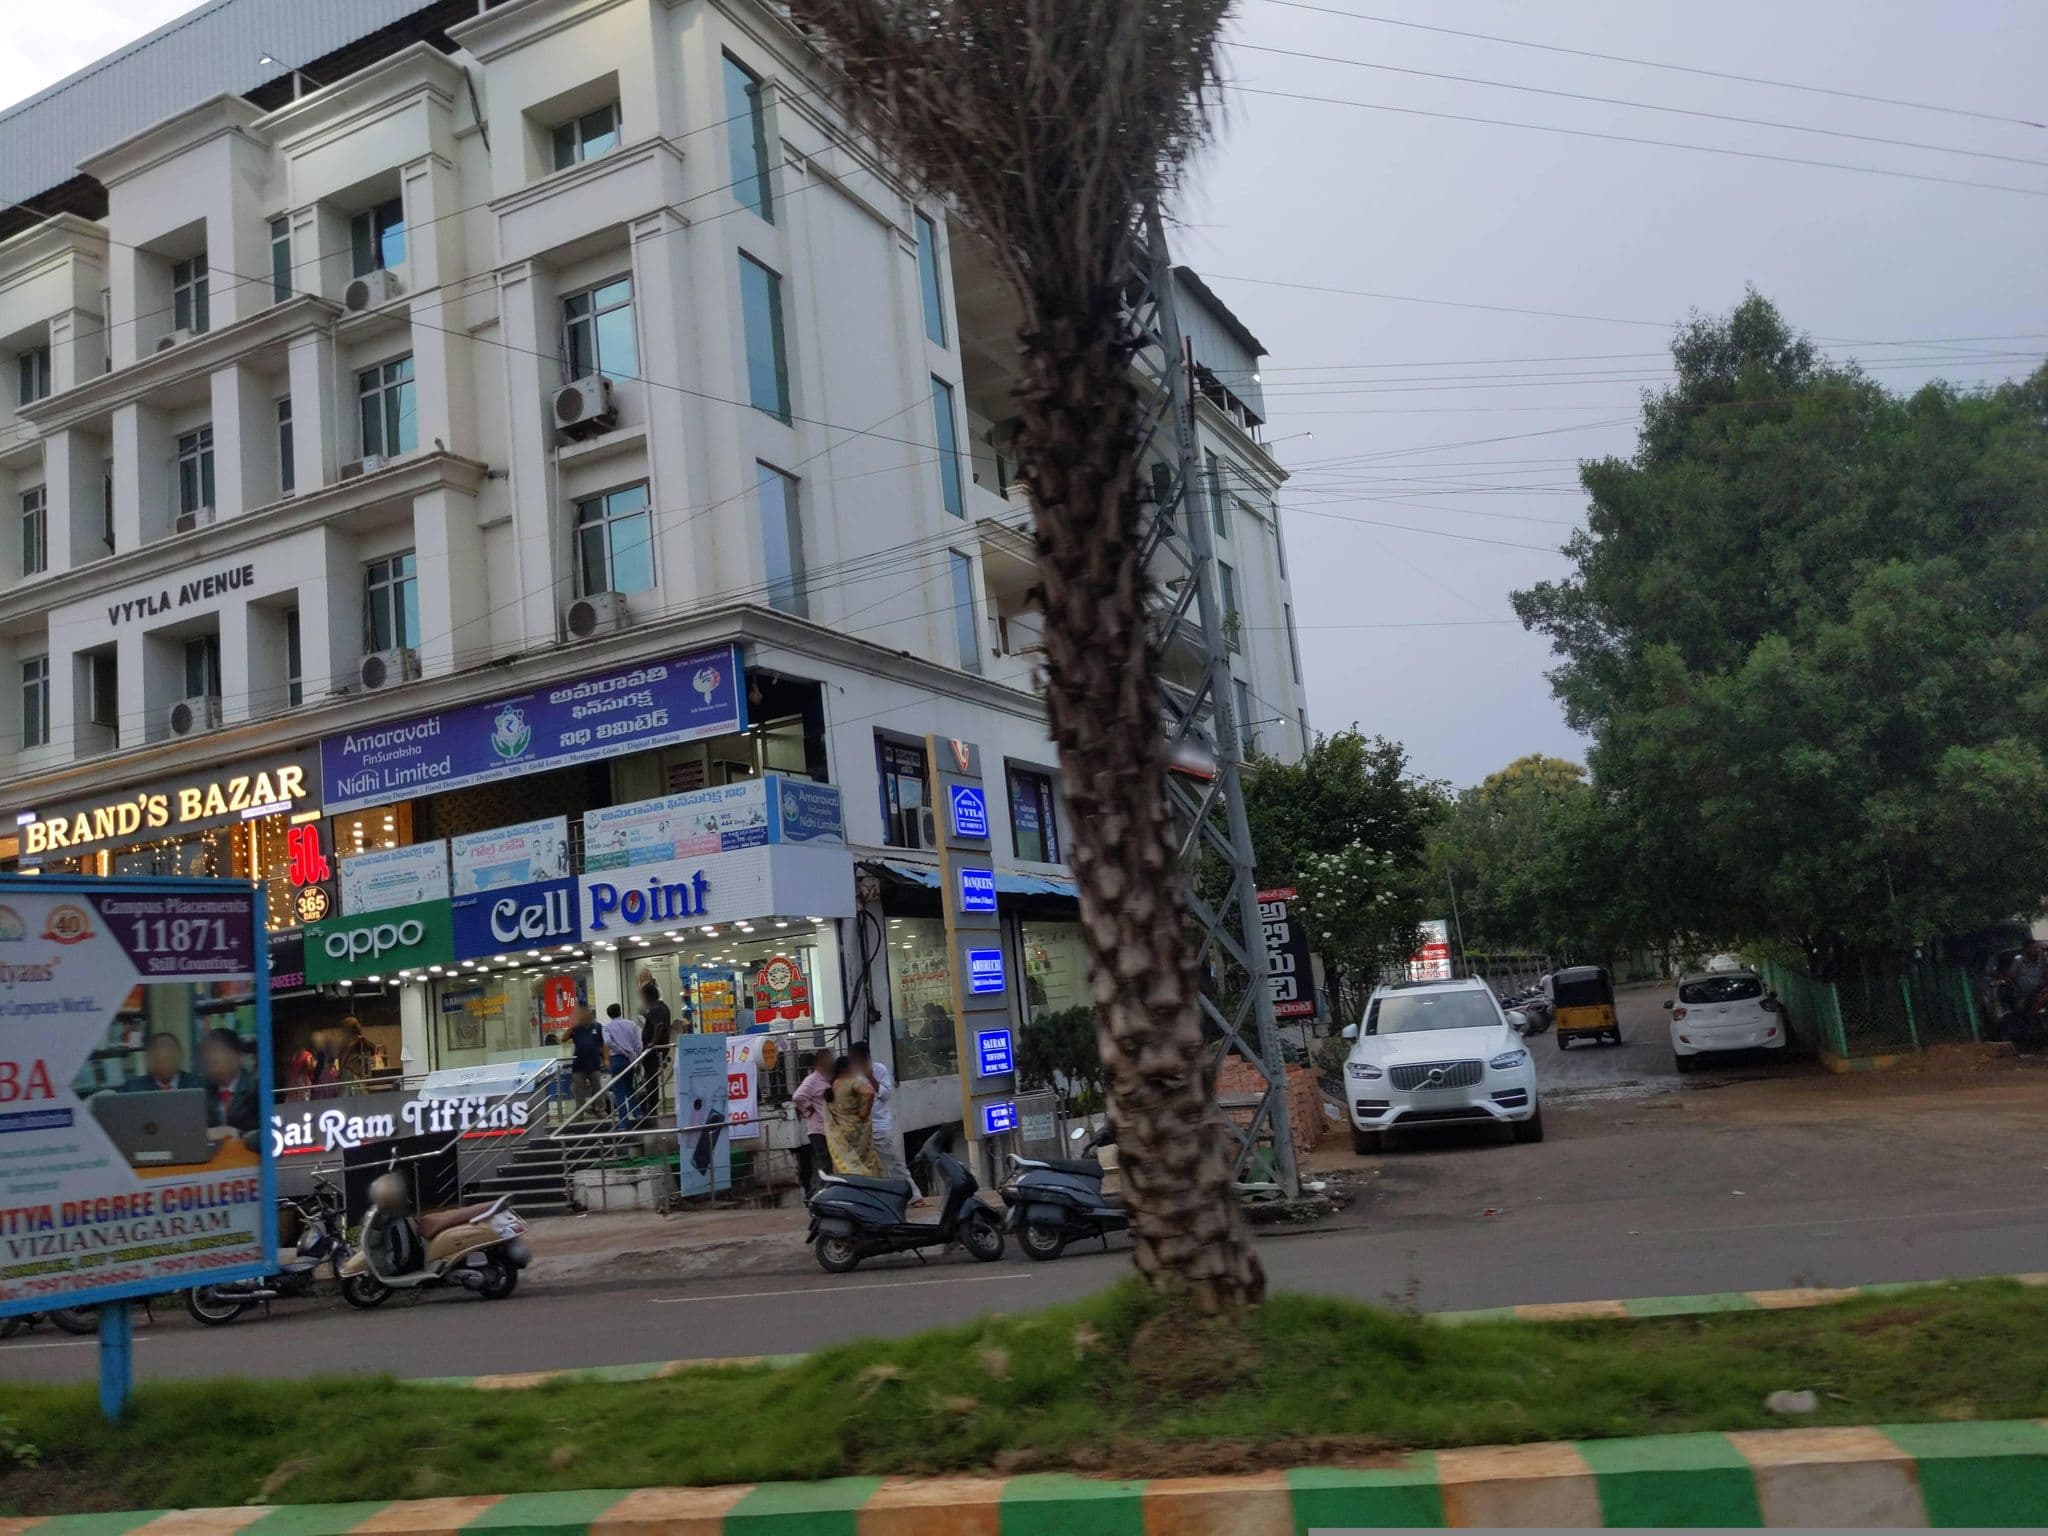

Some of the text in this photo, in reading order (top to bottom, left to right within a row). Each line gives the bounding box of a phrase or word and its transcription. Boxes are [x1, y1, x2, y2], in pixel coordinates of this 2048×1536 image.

[108, 564, 255, 626] VYTLA AVENUE
[549, 665, 669, 705] అమరావతి
[343, 715, 441, 757] Amaravati
[560, 707, 670, 748] నిధి లిమిటెడ్
[337, 754, 452, 798] Nidhi Limited
[362, 745, 422, 767] FinSuraksha
[178, 764, 308, 823] BAZAR
[287, 824, 330, 887] 50%
[101, 897, 250, 919] Campus Placements
[297, 895, 326, 914] 365
[304, 888, 318, 898] OFF
[490, 868, 711, 944] Cell Point
[303, 911, 321, 921] DAYS
[147, 956, 177, 972] Still
[318, 1109, 395, 1153] Ram
[401, 1095, 530, 1137] Tiffins
[61, 1190, 155, 1229] DEGREE
[162, 1177, 261, 1214] COLLEGE
[6, 1209, 232, 1260] VIZIANAGARAM
